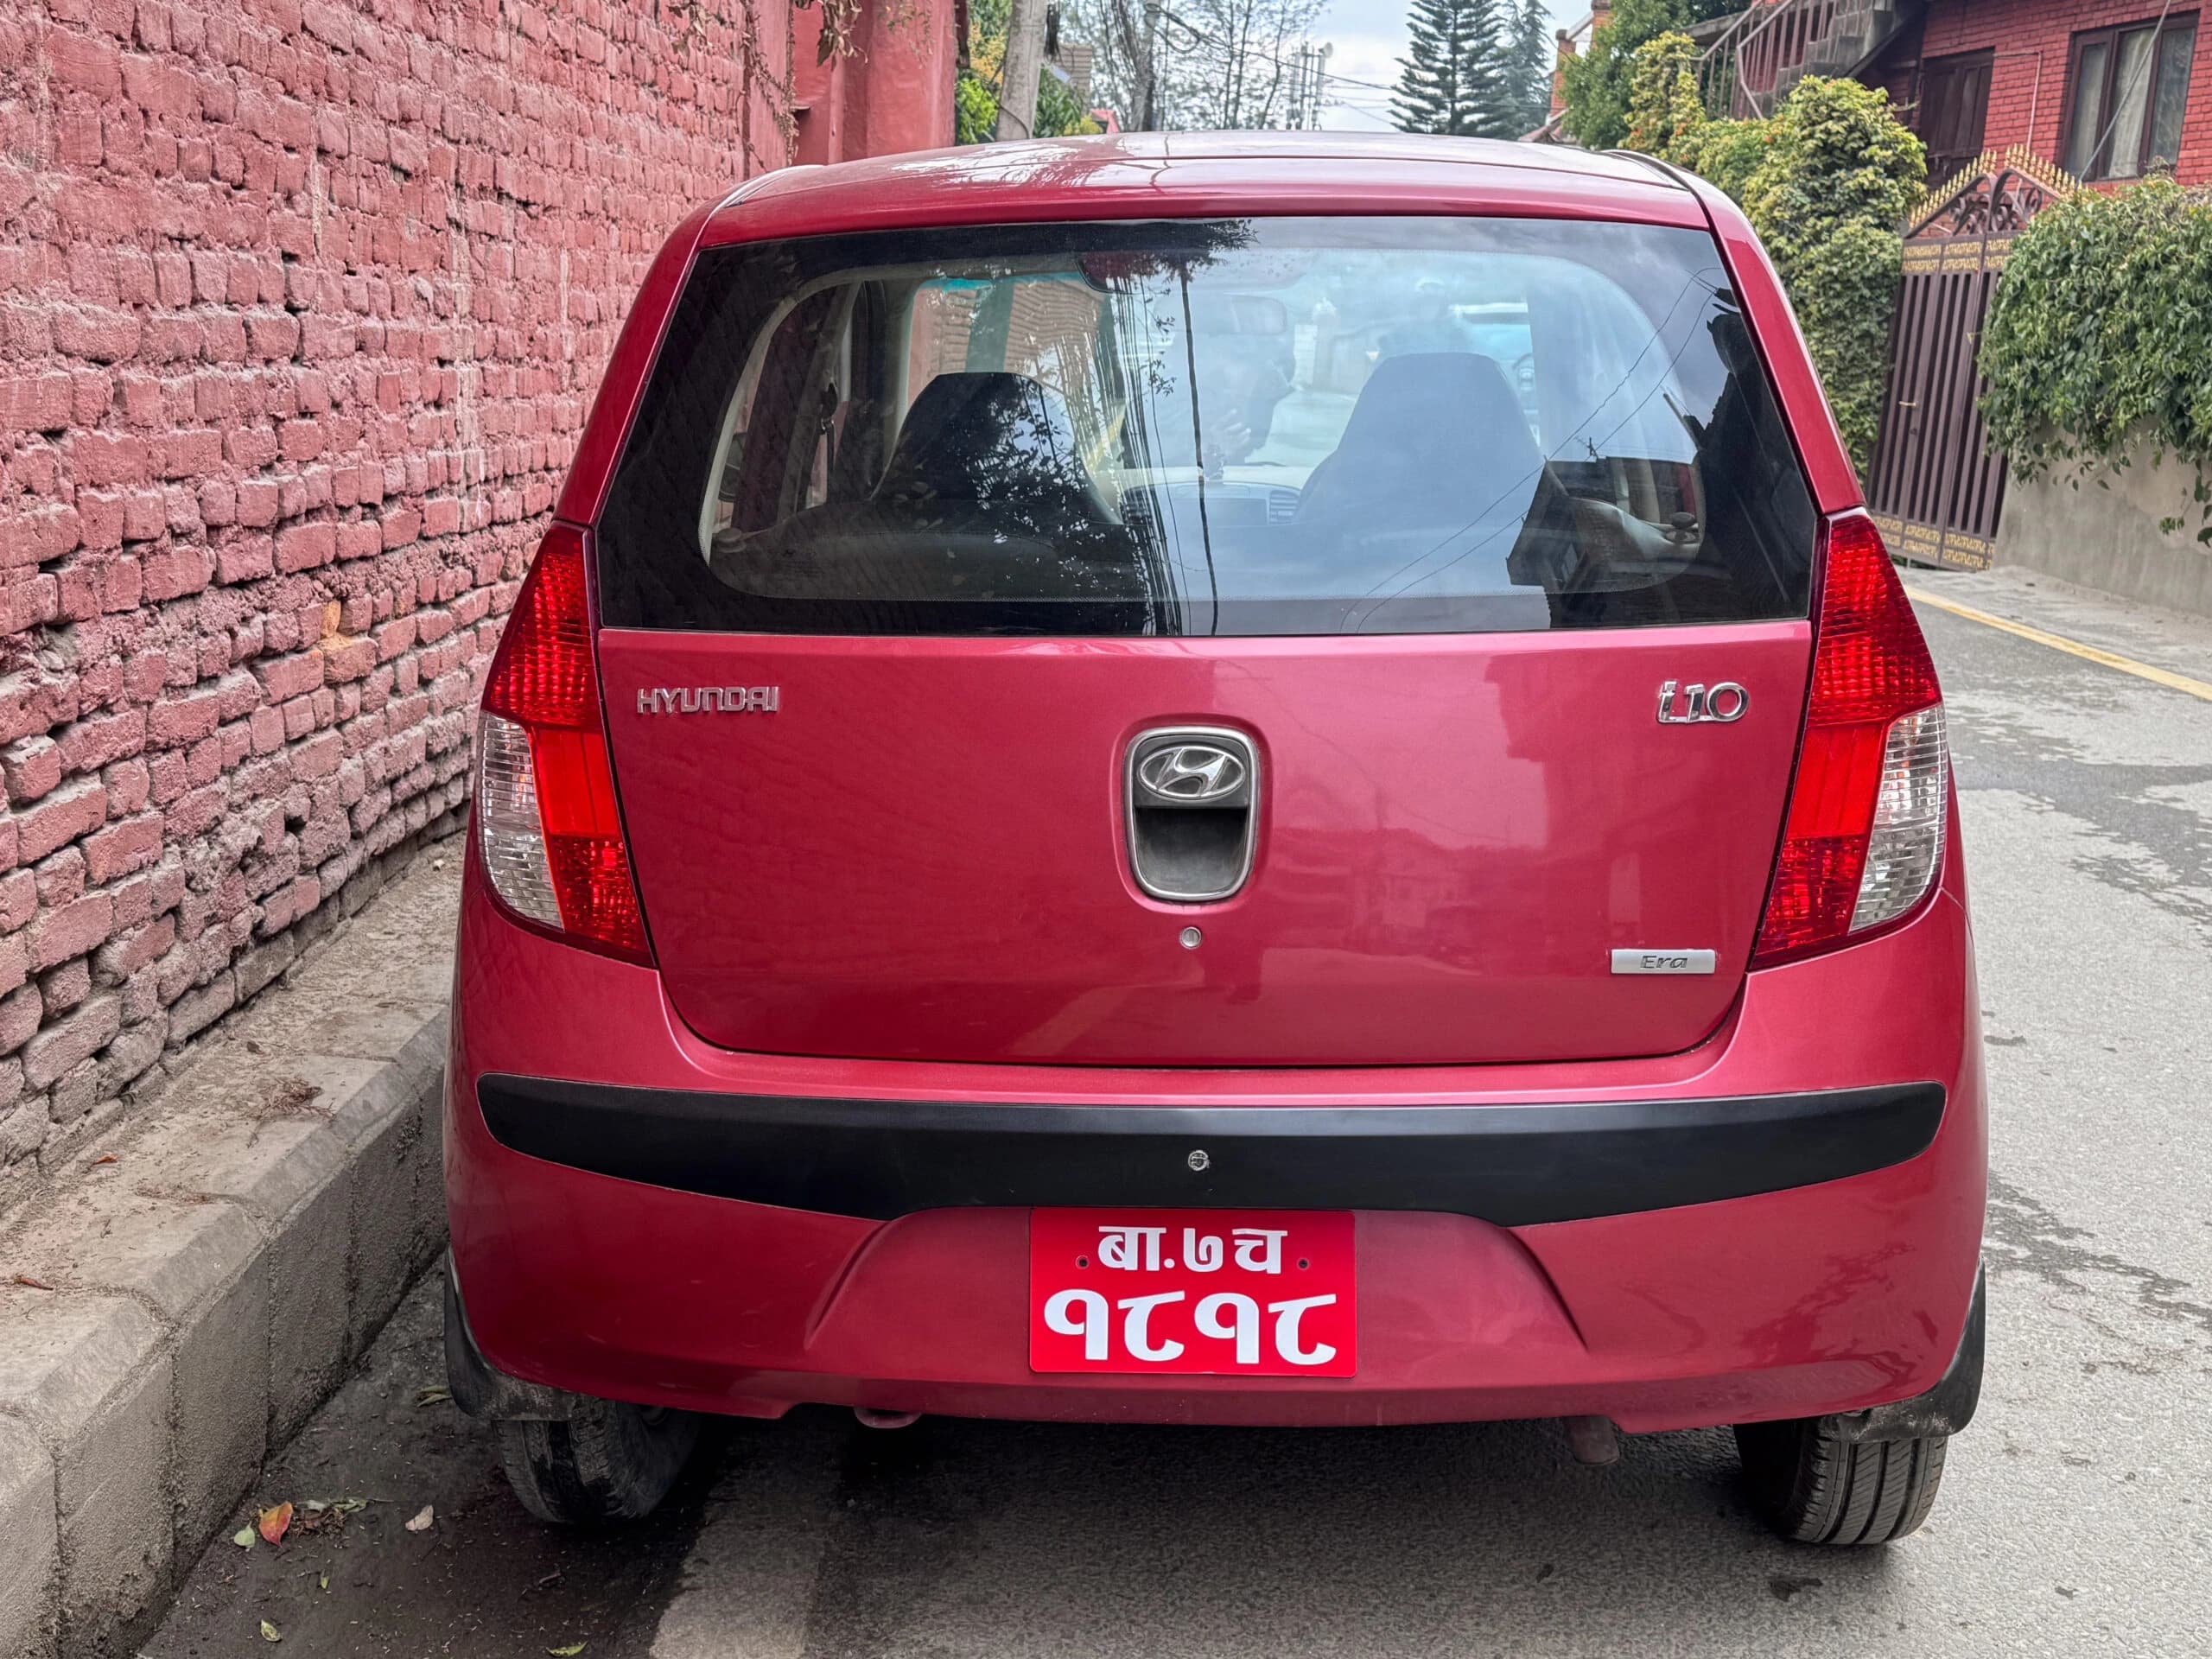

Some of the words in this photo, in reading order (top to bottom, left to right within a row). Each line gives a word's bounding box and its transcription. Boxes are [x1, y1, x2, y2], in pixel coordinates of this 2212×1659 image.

[636, 686, 780, 714] HYUNDAI
[1656, 680, 1750, 723] i10
[1639, 955, 1688, 969] Era
[1044, 1288, 1337, 1365] १८१८
